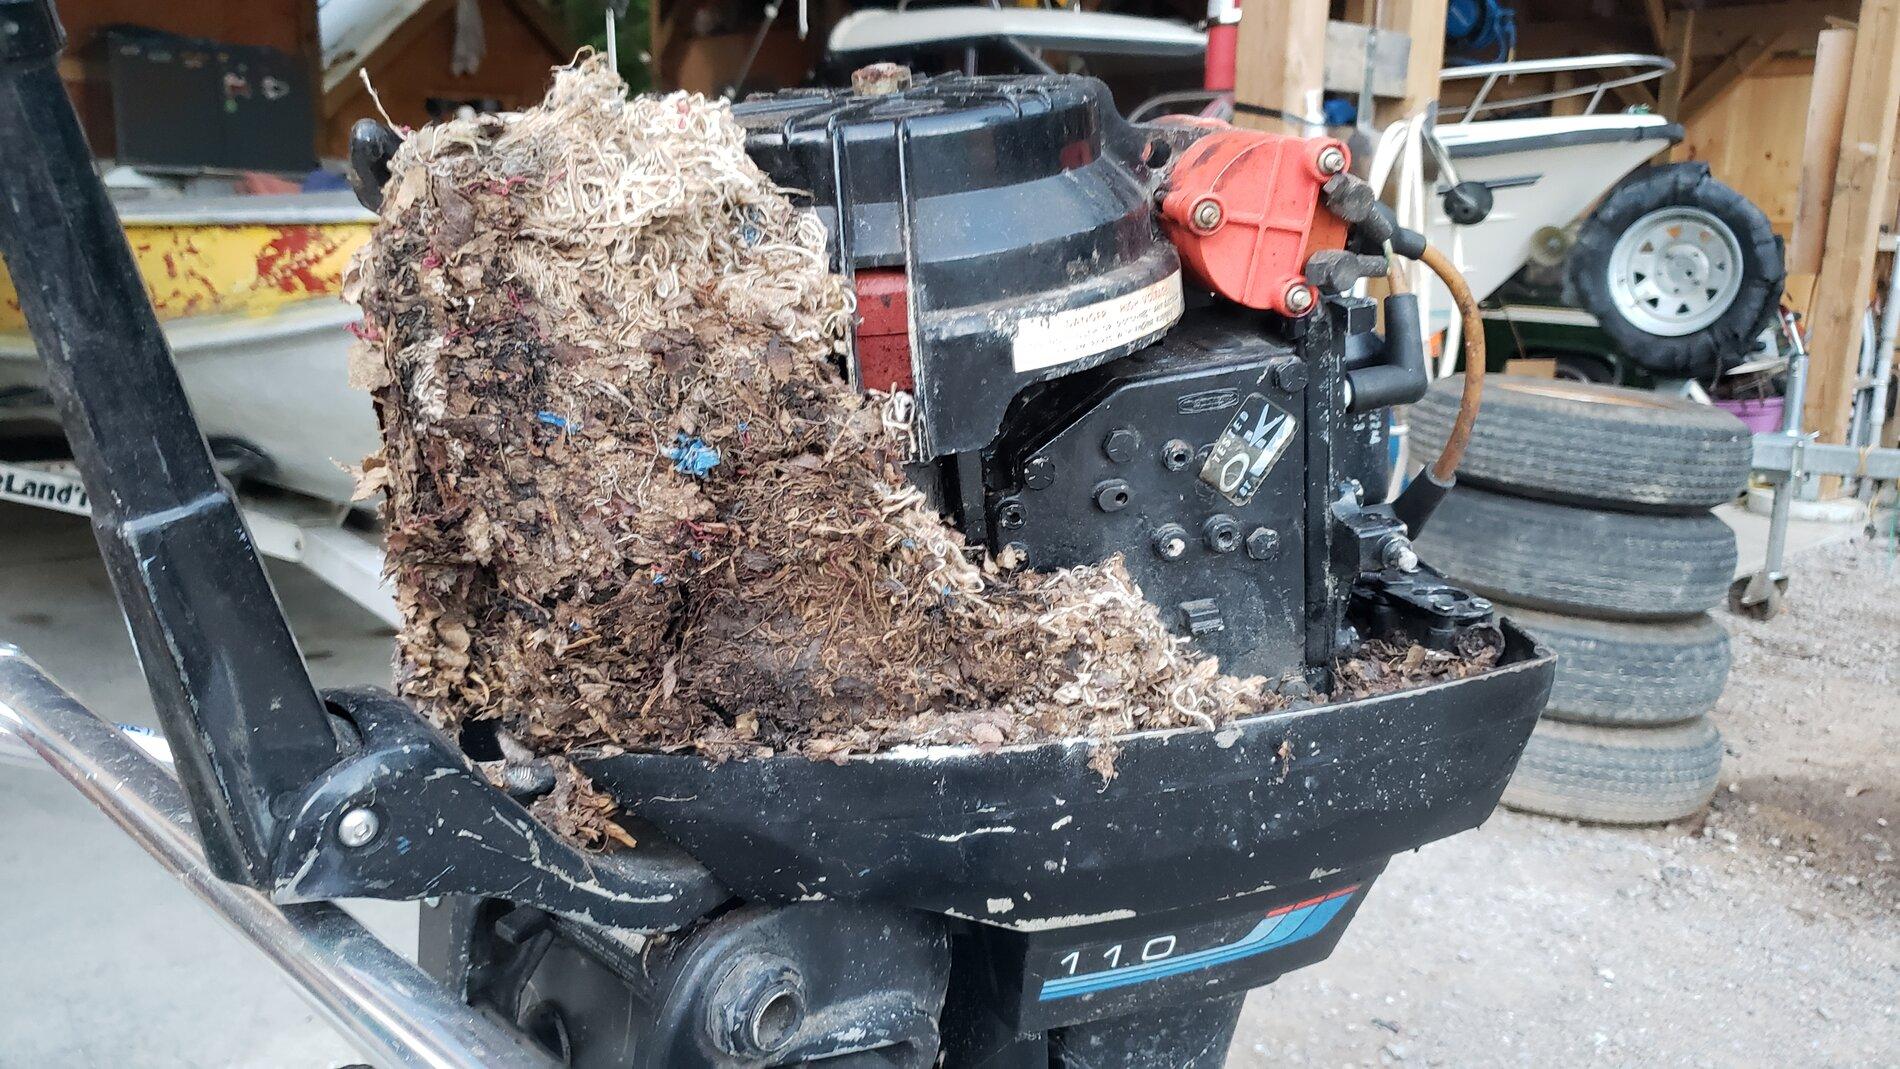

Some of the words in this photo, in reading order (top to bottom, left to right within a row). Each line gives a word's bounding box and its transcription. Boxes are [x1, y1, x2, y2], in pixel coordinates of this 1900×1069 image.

[1211, 410, 1249, 463] TESTED
[1219, 403, 1285, 493] OK
[1060, 935, 1177, 975] 110
